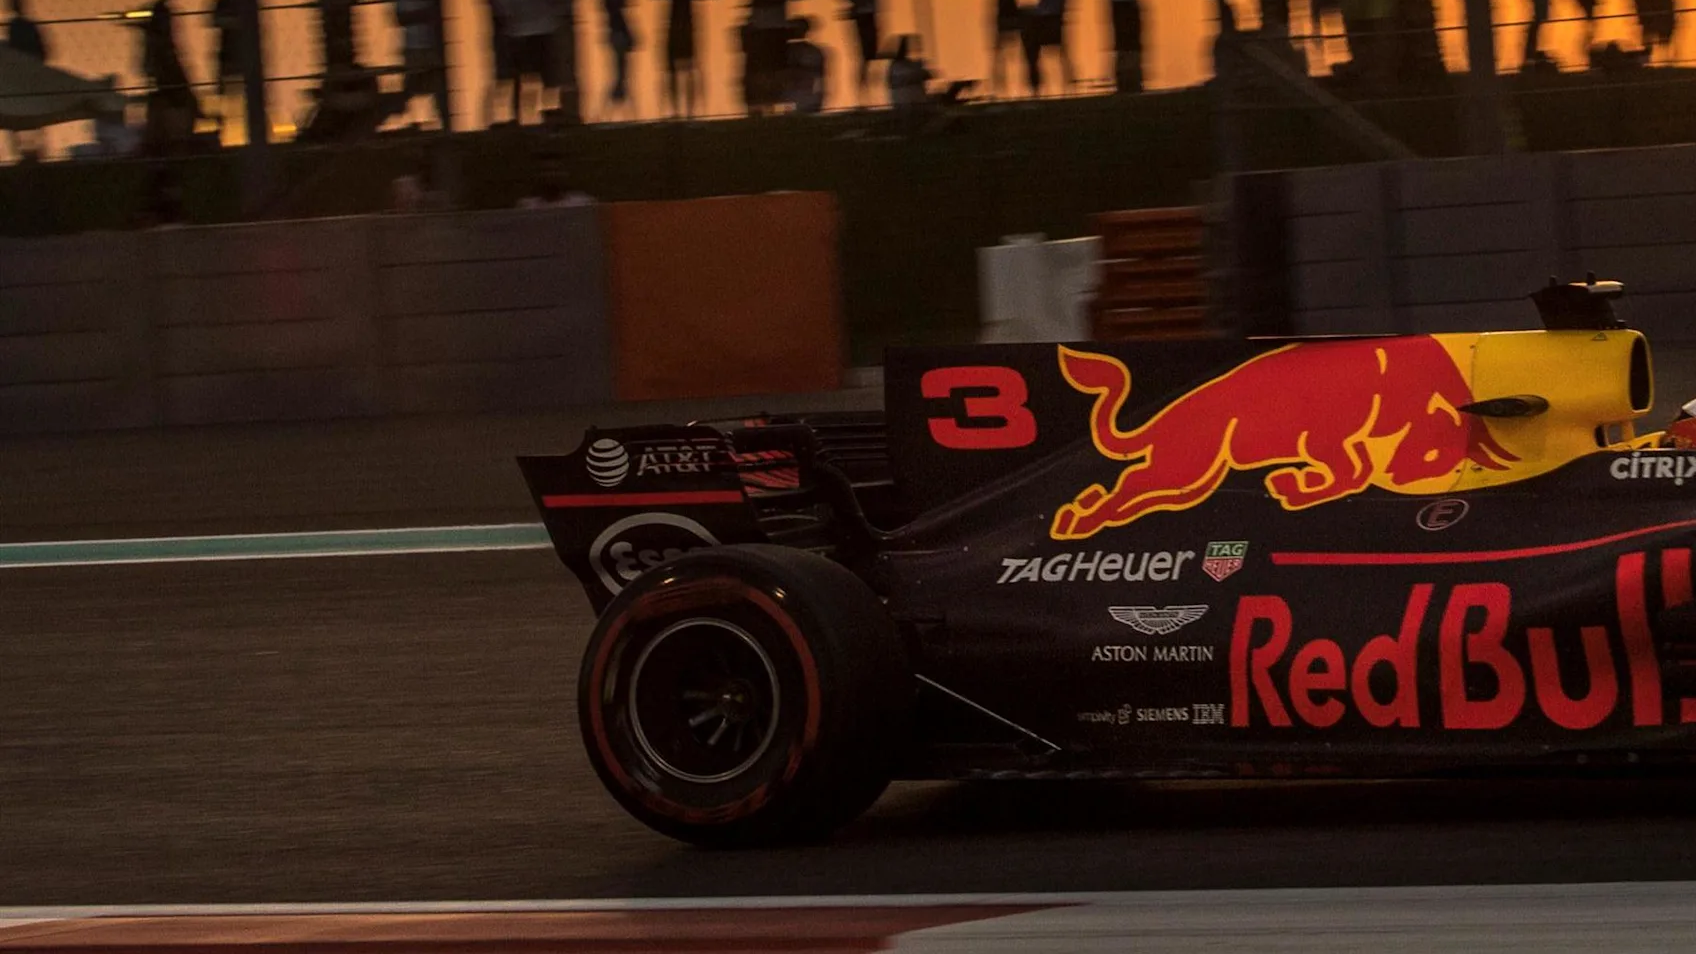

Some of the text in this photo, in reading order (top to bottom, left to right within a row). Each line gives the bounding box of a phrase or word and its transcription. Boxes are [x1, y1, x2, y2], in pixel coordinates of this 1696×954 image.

[921, 366, 1037, 450] 3
[637, 446, 717, 477] AT&T
[1211, 544, 1244, 556] TAG
[1091, 645, 1214, 662] ASTON MARTIN
[1136, 707, 1190, 722] SIEMENS
[1192, 703, 1225, 725] IBM
